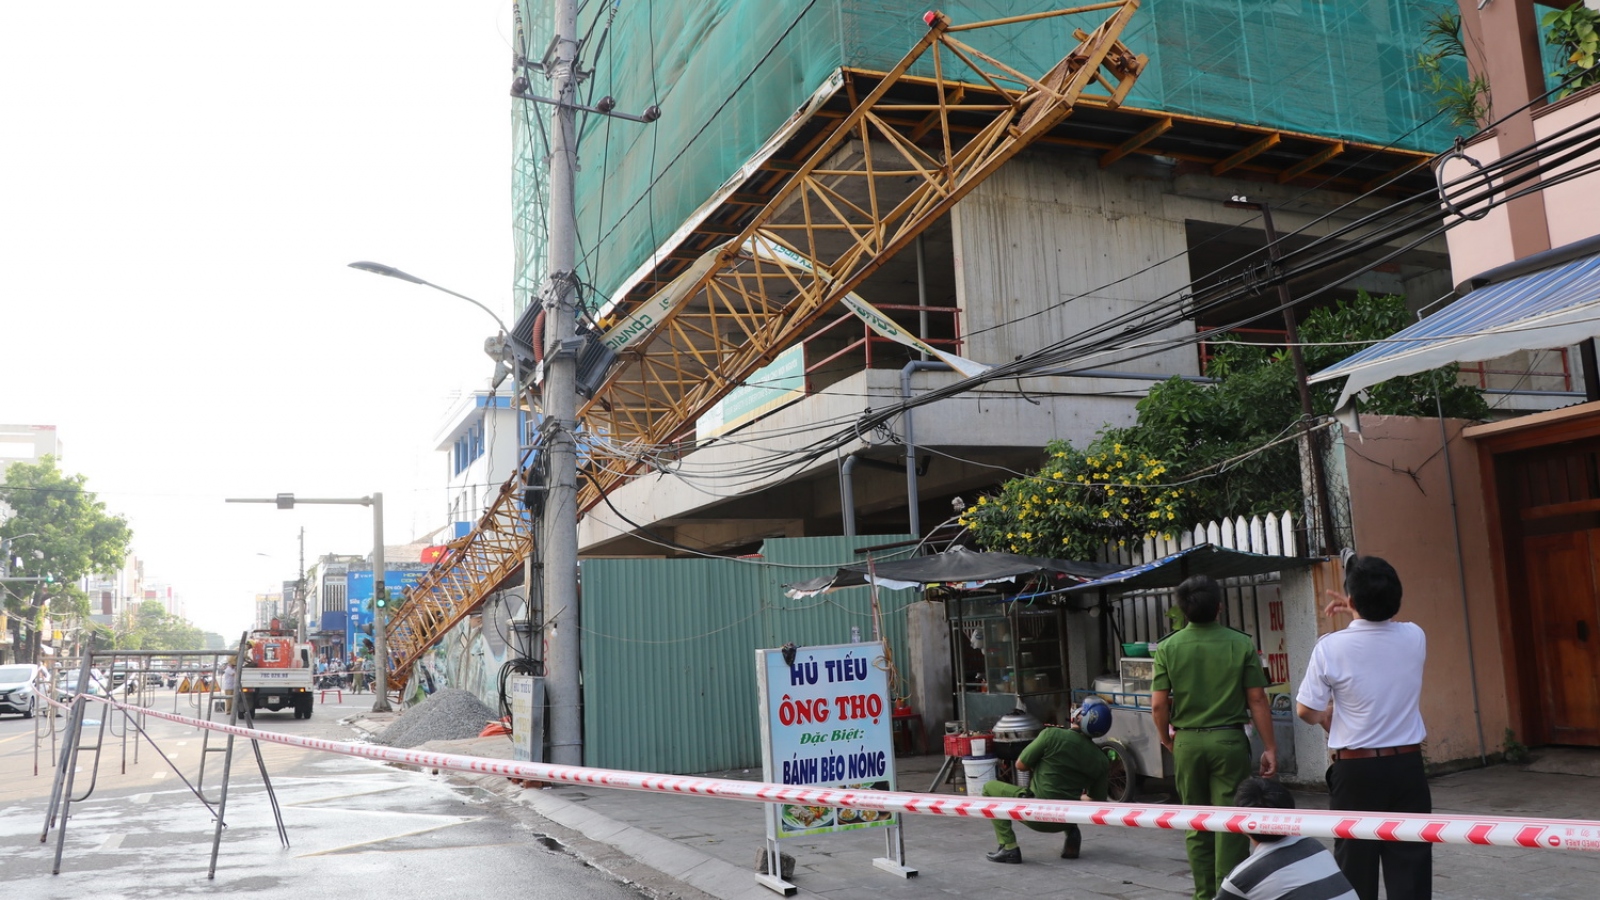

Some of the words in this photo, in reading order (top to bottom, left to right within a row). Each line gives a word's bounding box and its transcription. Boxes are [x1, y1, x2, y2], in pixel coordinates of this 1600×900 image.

[790, 655, 819, 686] HỦ
[824, 651, 868, 683] TIẾU
[779, 693, 830, 726] ÔNG
[835, 693, 882, 725] THỌ
[800, 731, 829, 746] Đặc
[830, 728, 864, 743] Biệt:
[783, 752, 818, 785] BÁNH
[820, 749, 846, 783] BÈO
[848, 745, 886, 779] NÓNG
